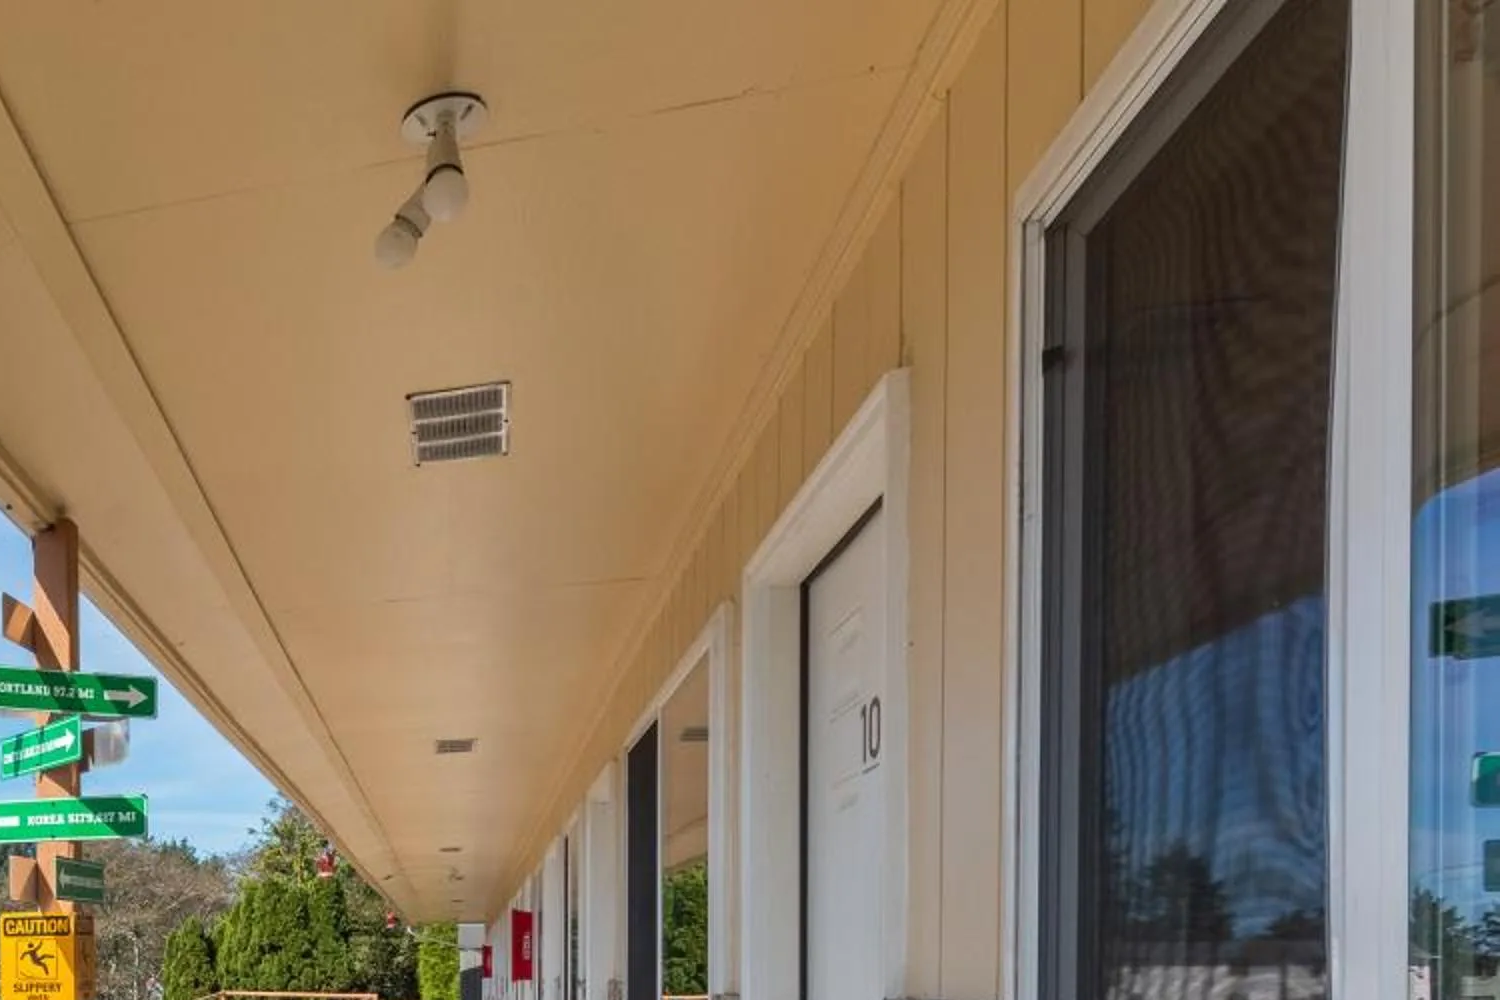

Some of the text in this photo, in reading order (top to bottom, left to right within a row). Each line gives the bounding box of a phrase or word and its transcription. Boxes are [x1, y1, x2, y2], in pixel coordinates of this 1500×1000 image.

[861, 695, 881, 764] 10
[5, 919, 69, 934] CAUTION
[13, 983, 61, 992] SLIPPERY
